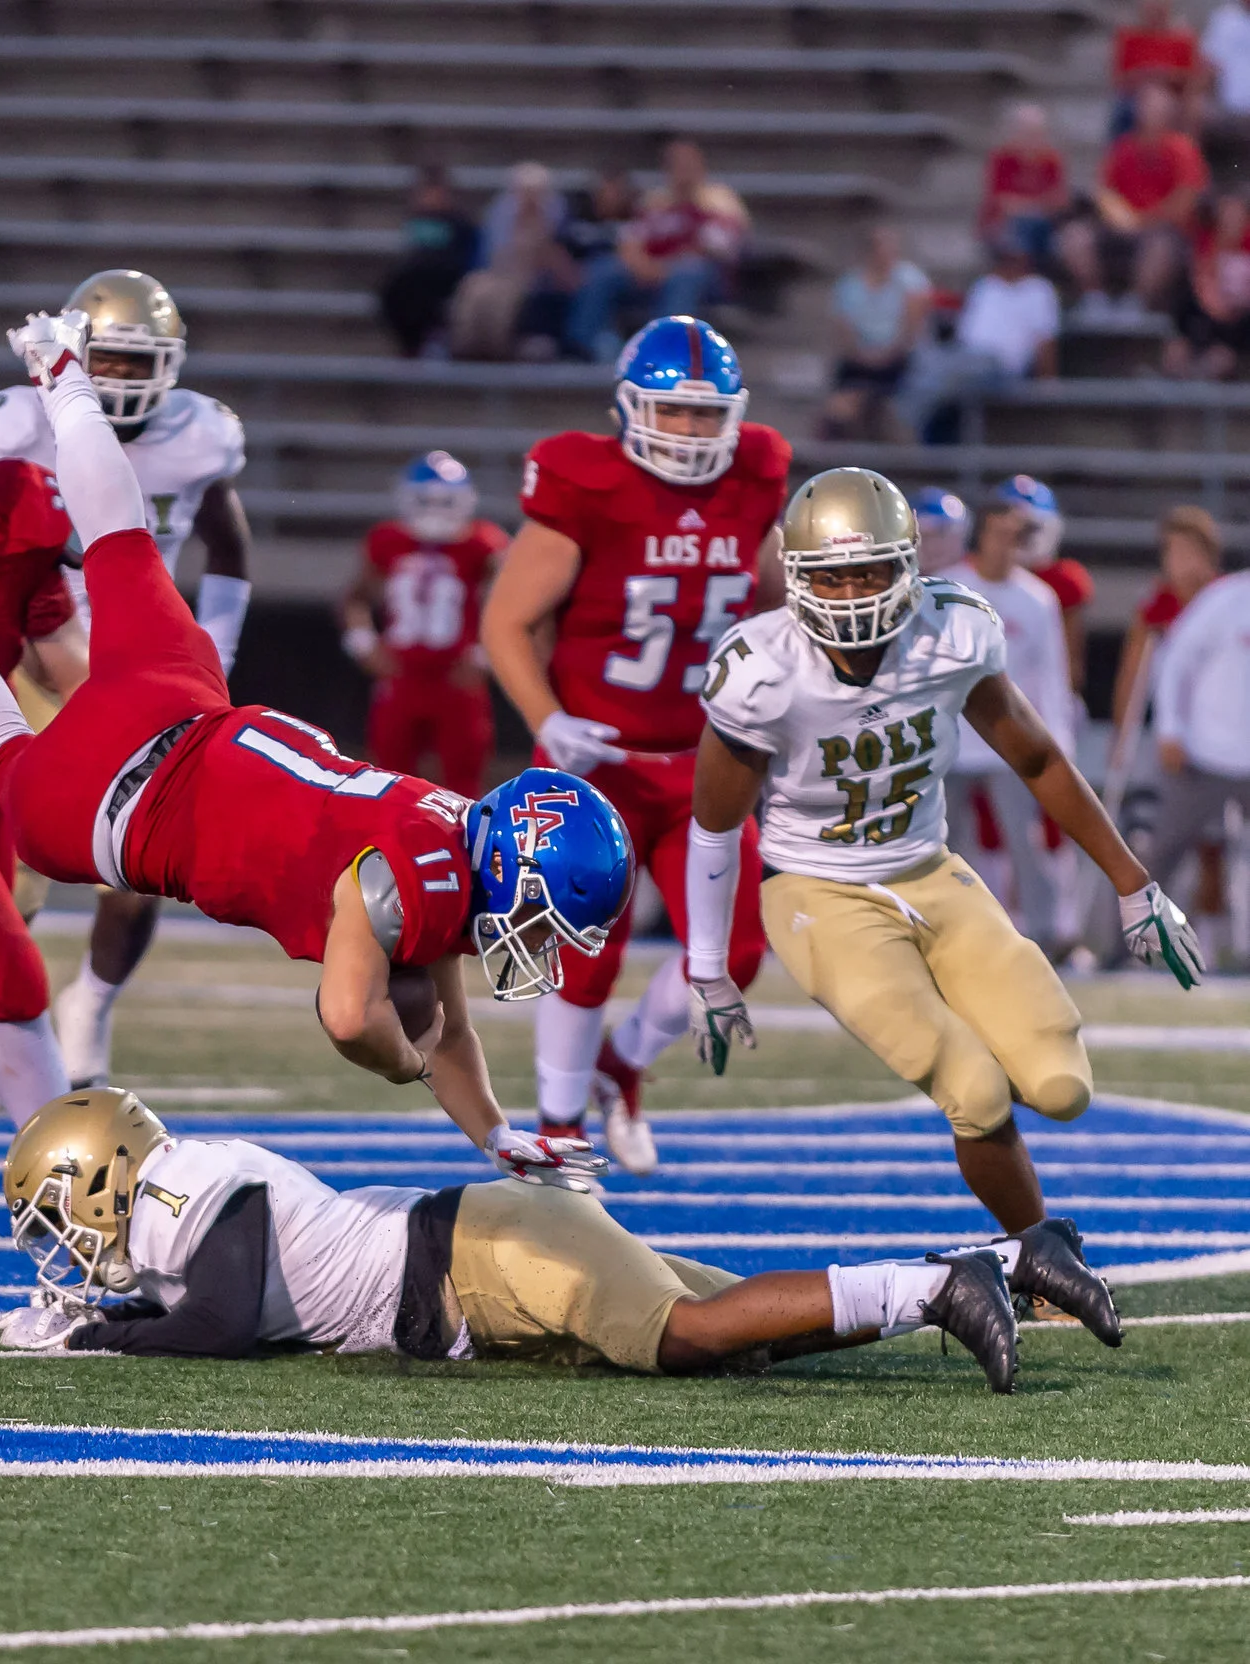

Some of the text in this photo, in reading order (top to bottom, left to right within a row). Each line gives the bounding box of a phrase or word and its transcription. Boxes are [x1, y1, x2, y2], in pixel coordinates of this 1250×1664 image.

[644, 533, 742, 568] LOS AL
[602, 571, 754, 694] 55
[817, 705, 937, 778] POLY
[819, 757, 933, 846] 15
[414, 848, 461, 893] 17
